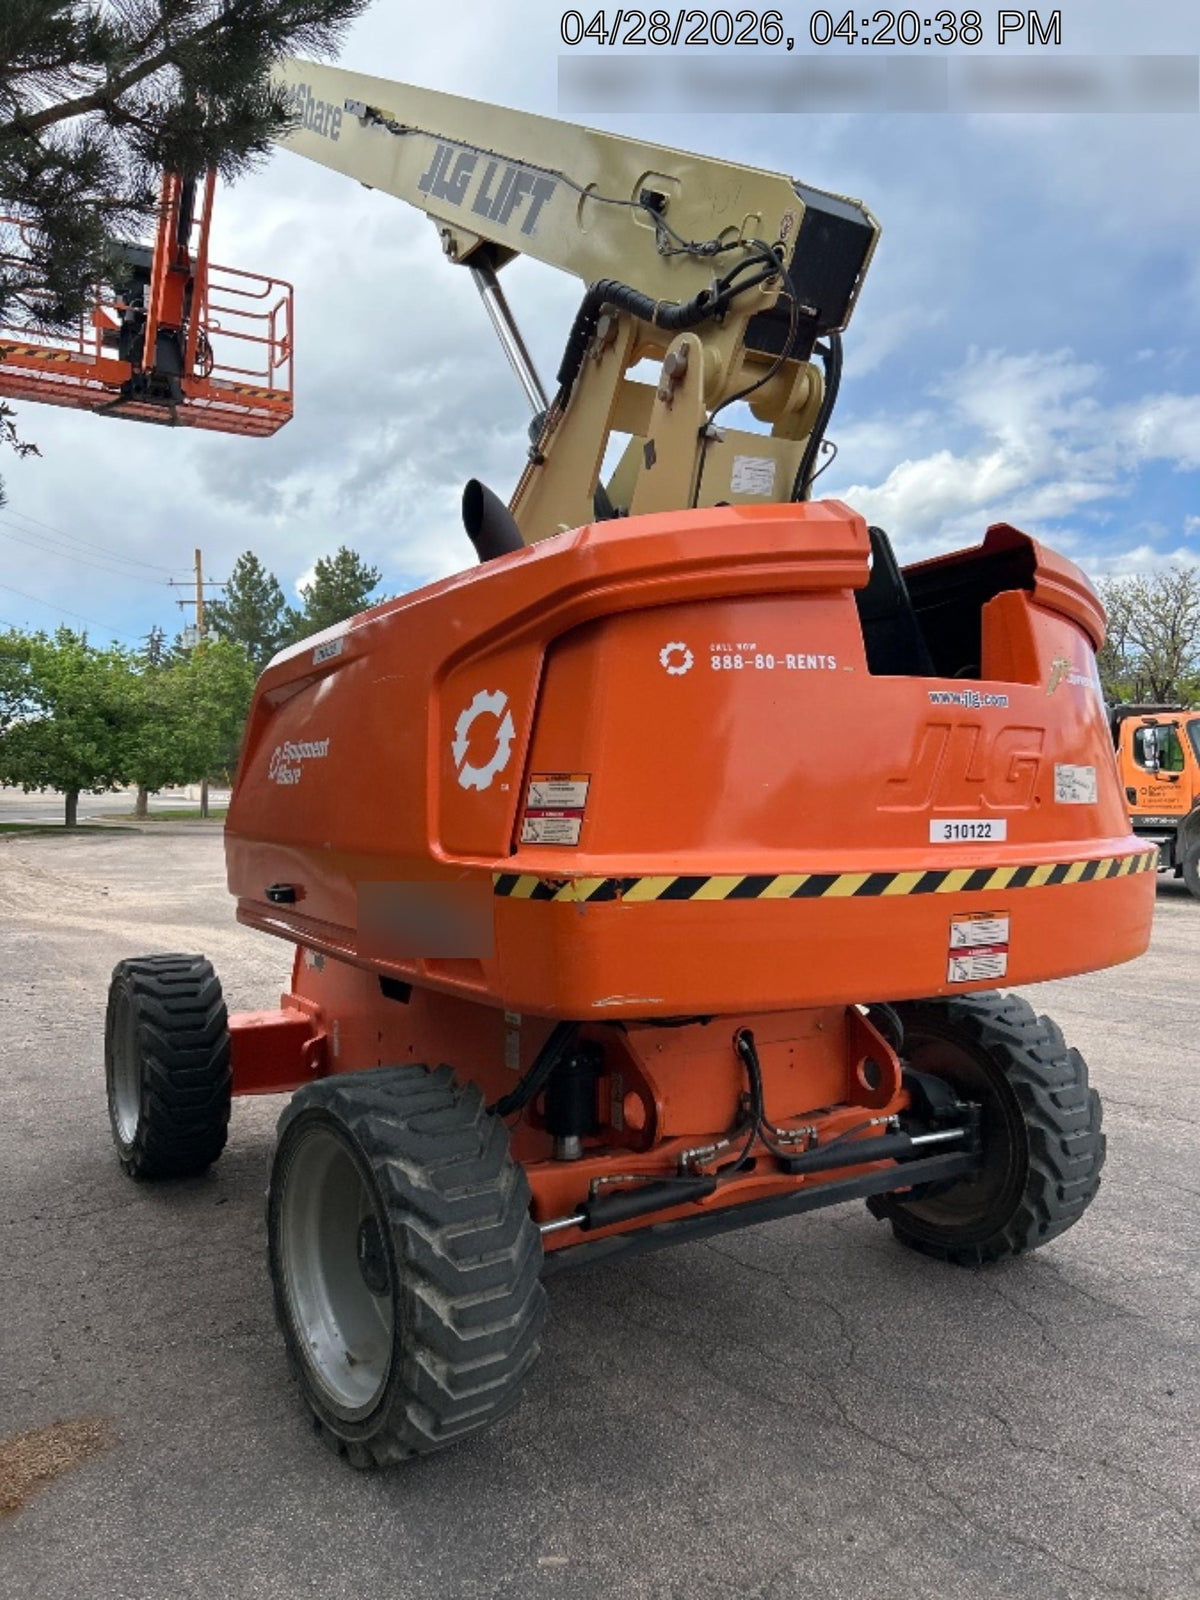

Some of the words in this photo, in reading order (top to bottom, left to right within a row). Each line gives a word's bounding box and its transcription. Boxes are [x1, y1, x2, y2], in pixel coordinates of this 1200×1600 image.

[417, 143, 479, 207] JLG
[471, 160, 558, 236] LIFT
[710, 643, 733, 652] CALL
[737, 643, 757, 651] NOW
[710, 653, 837, 670] 888-80-RENTS
[927, 689, 1009, 709] www.jlg.com
[876, 721, 1046, 812] JLG
[943, 823, 992, 840] 310122
